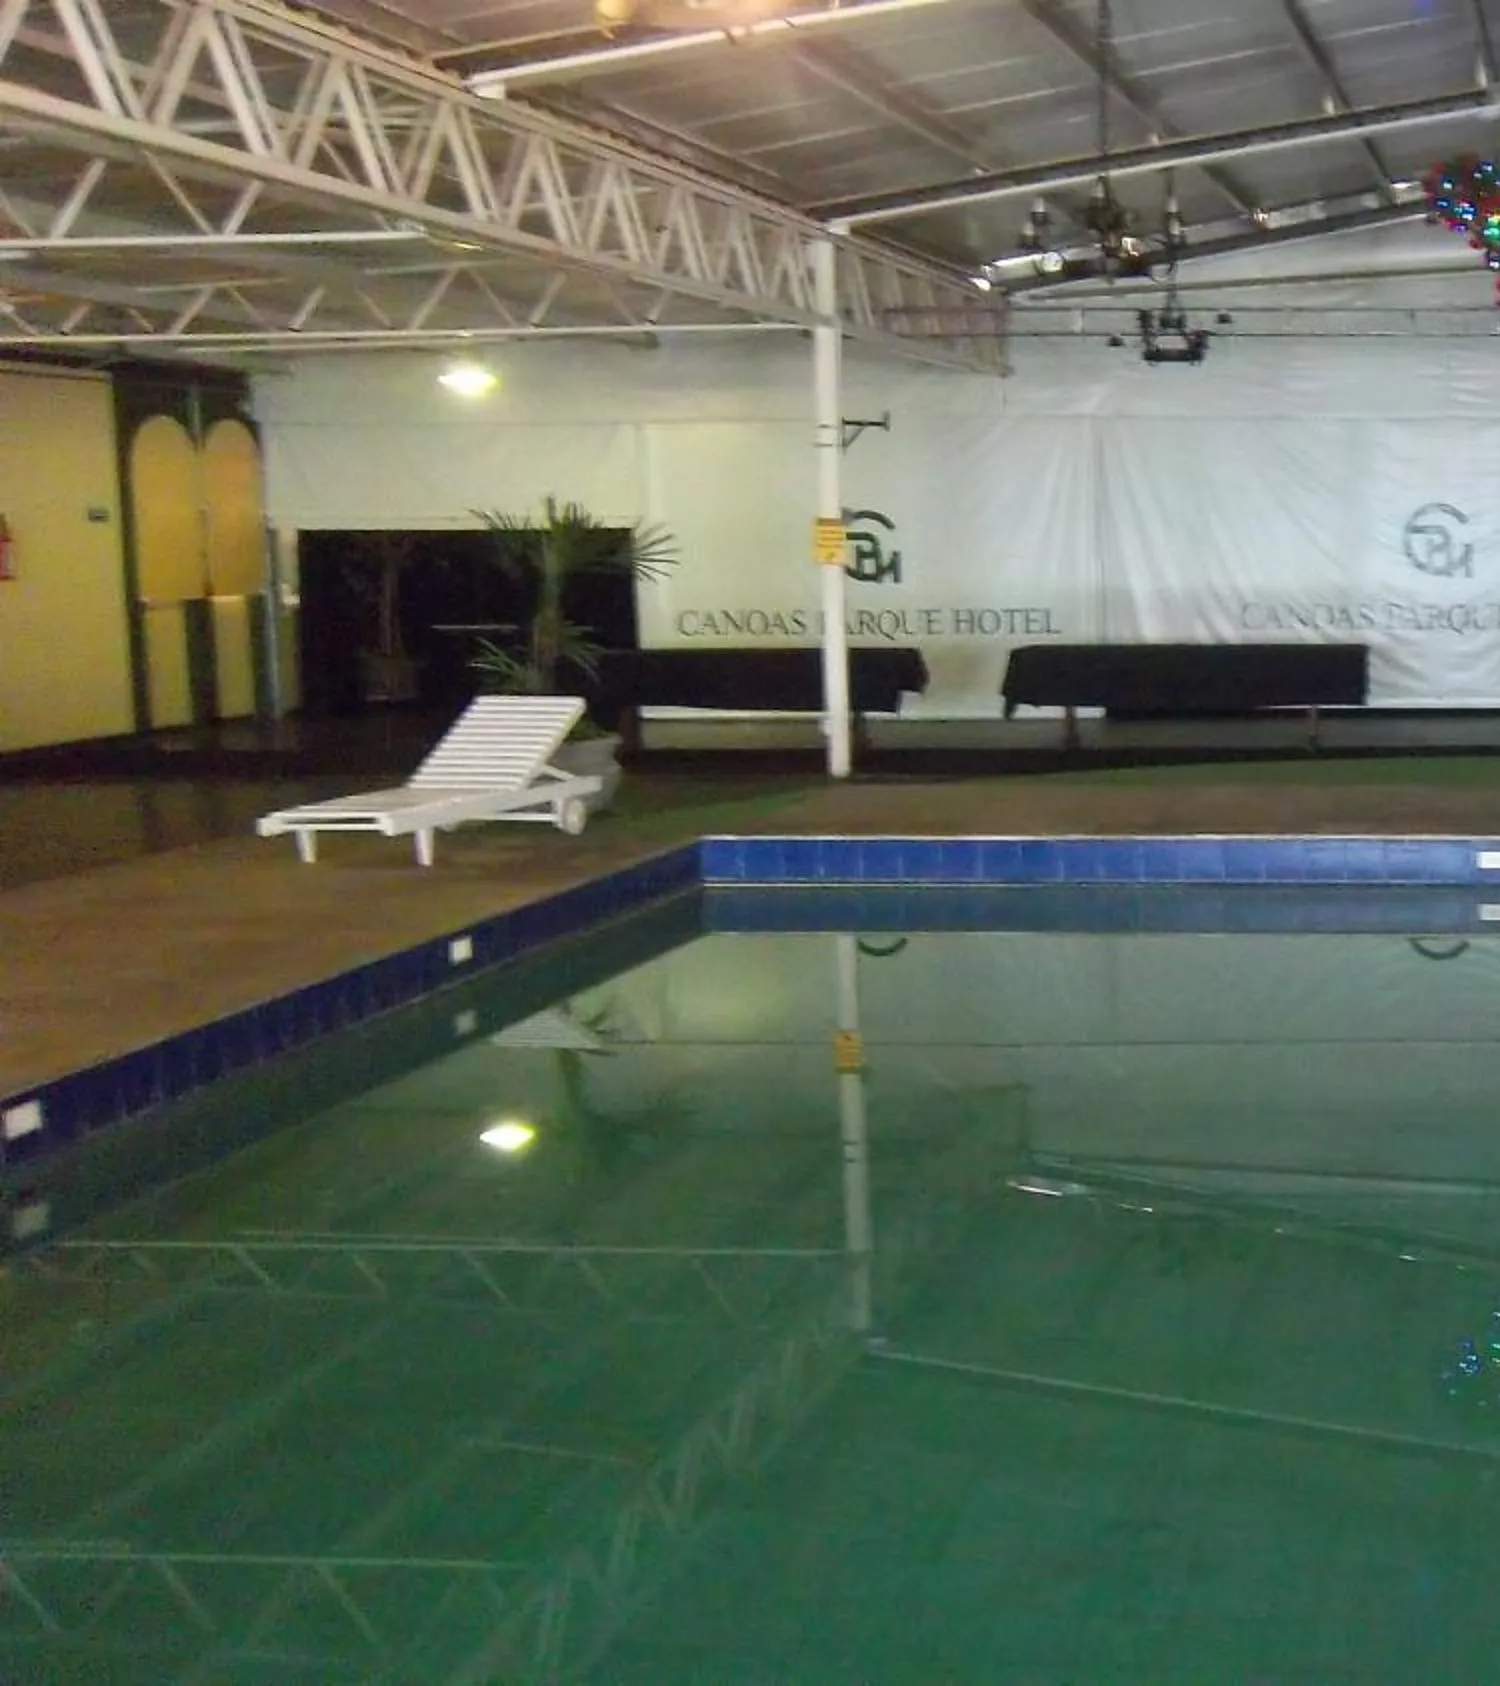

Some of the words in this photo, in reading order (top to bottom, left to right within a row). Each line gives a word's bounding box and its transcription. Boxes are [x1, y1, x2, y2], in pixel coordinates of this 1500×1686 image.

[677, 608, 807, 636] CANOAS
[818, 608, 944, 641] RQUE
[954, 607, 1061, 635] HOTEL
[1241, 602, 1376, 630] CANOAS
